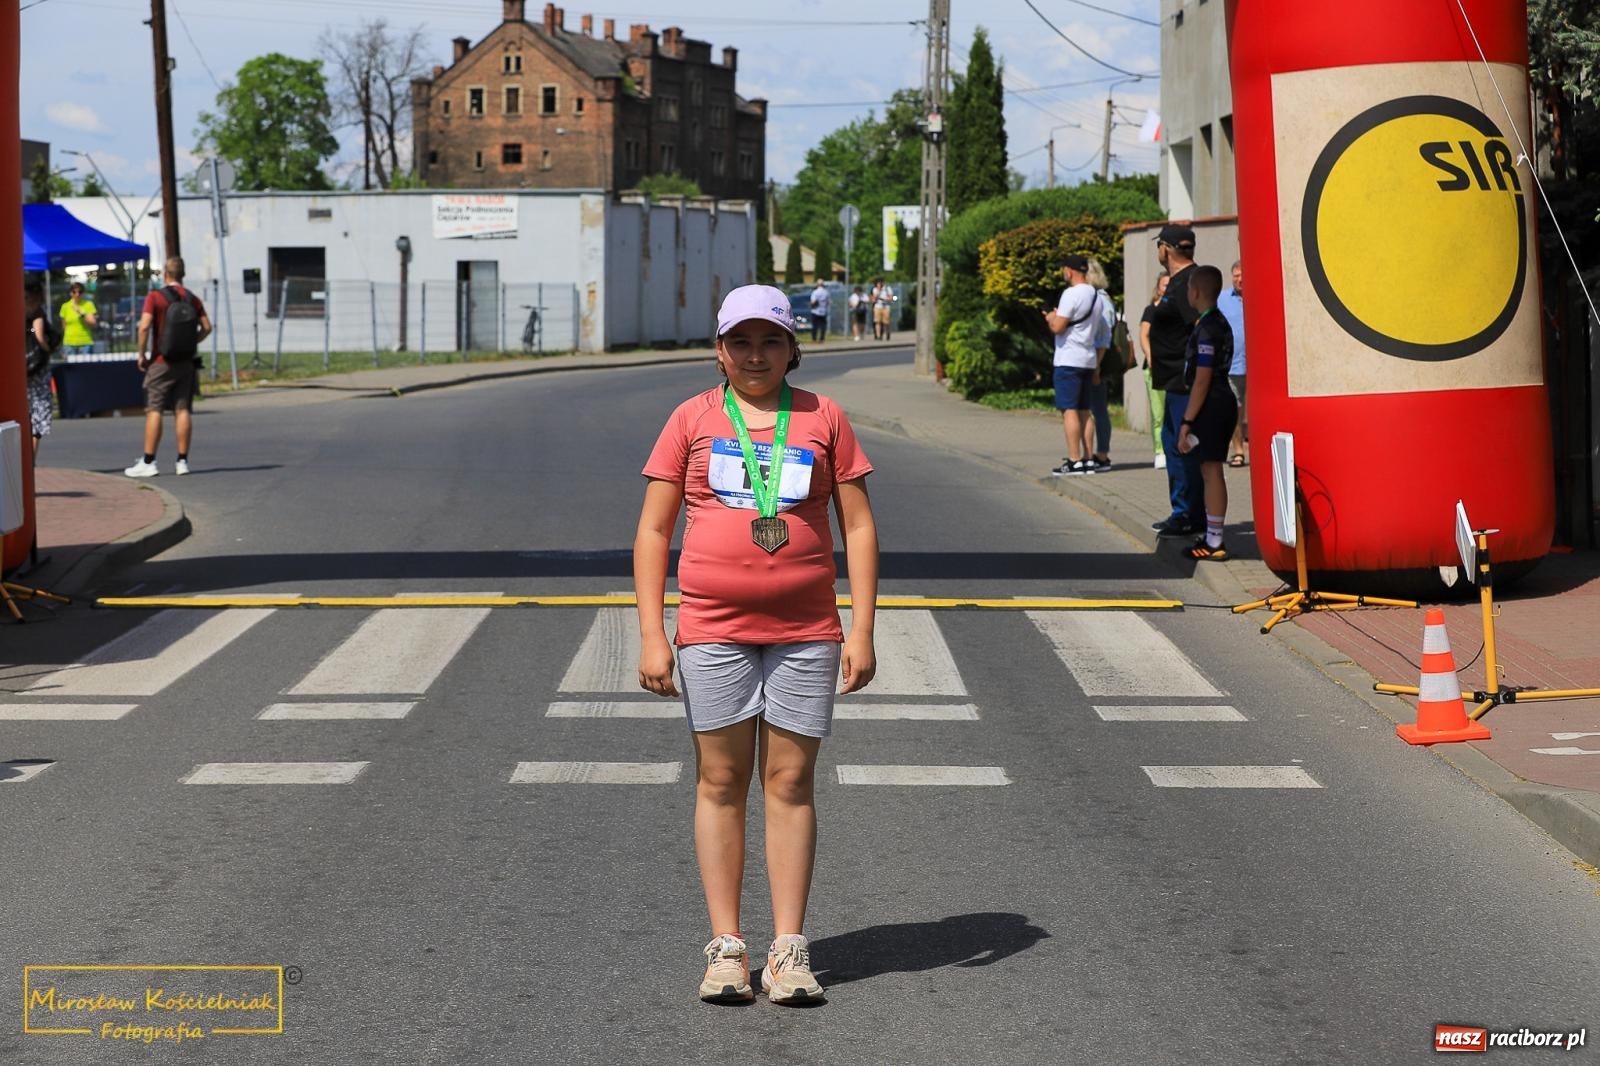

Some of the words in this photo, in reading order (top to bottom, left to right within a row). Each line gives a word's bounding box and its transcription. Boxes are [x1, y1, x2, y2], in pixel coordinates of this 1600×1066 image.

[1419, 140, 1522, 192] SIR
[771, 306, 785, 316] 4F
[724, 440, 740, 449] XVI
[757, 445, 771, 453] BEZ
